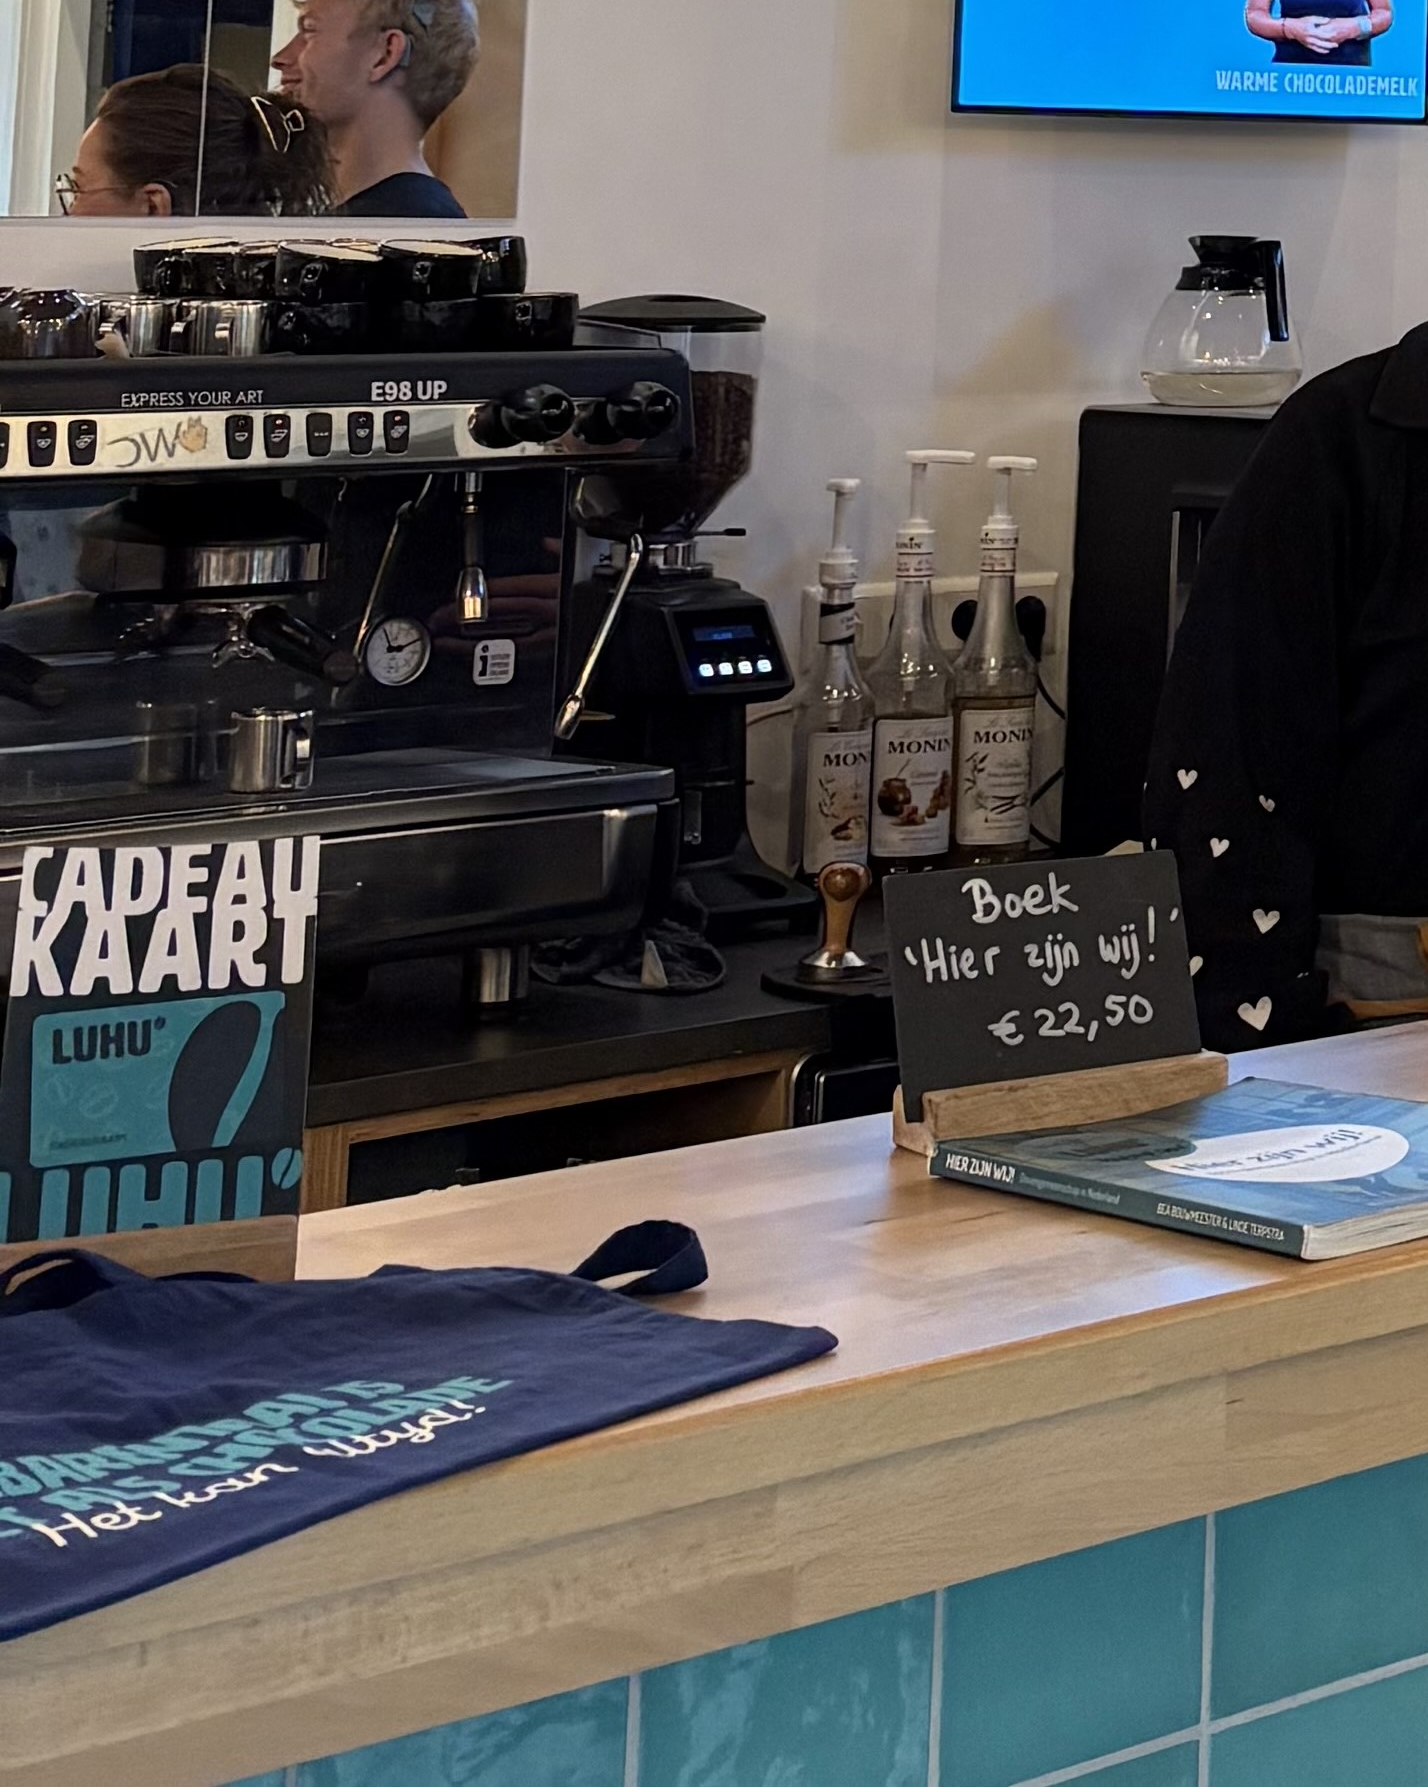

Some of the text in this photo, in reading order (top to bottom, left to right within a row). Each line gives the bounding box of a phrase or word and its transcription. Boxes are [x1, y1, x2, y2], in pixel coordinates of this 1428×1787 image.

[1216, 70, 1419, 97] WARME CHOCOLADEMELK
[121, 389, 264, 408] EXPRESS YOUR ART
[371, 380, 447, 402] E98 UP
[18, 835, 320, 917] CADEAU
[960, 871, 1080, 924] Boek
[9, 906, 317, 997] KAART
[1024, 932, 1080, 987] zijn
[52, 1018, 153, 1065] LUHU
[1033, 994, 1154, 1043] 22,50
[945, 1153, 969, 1172] HIER
[969, 1157, 992, 1179] ZIJN
[32, 1501, 162, 1548] Het
[154, 1461, 299, 1507] kan
